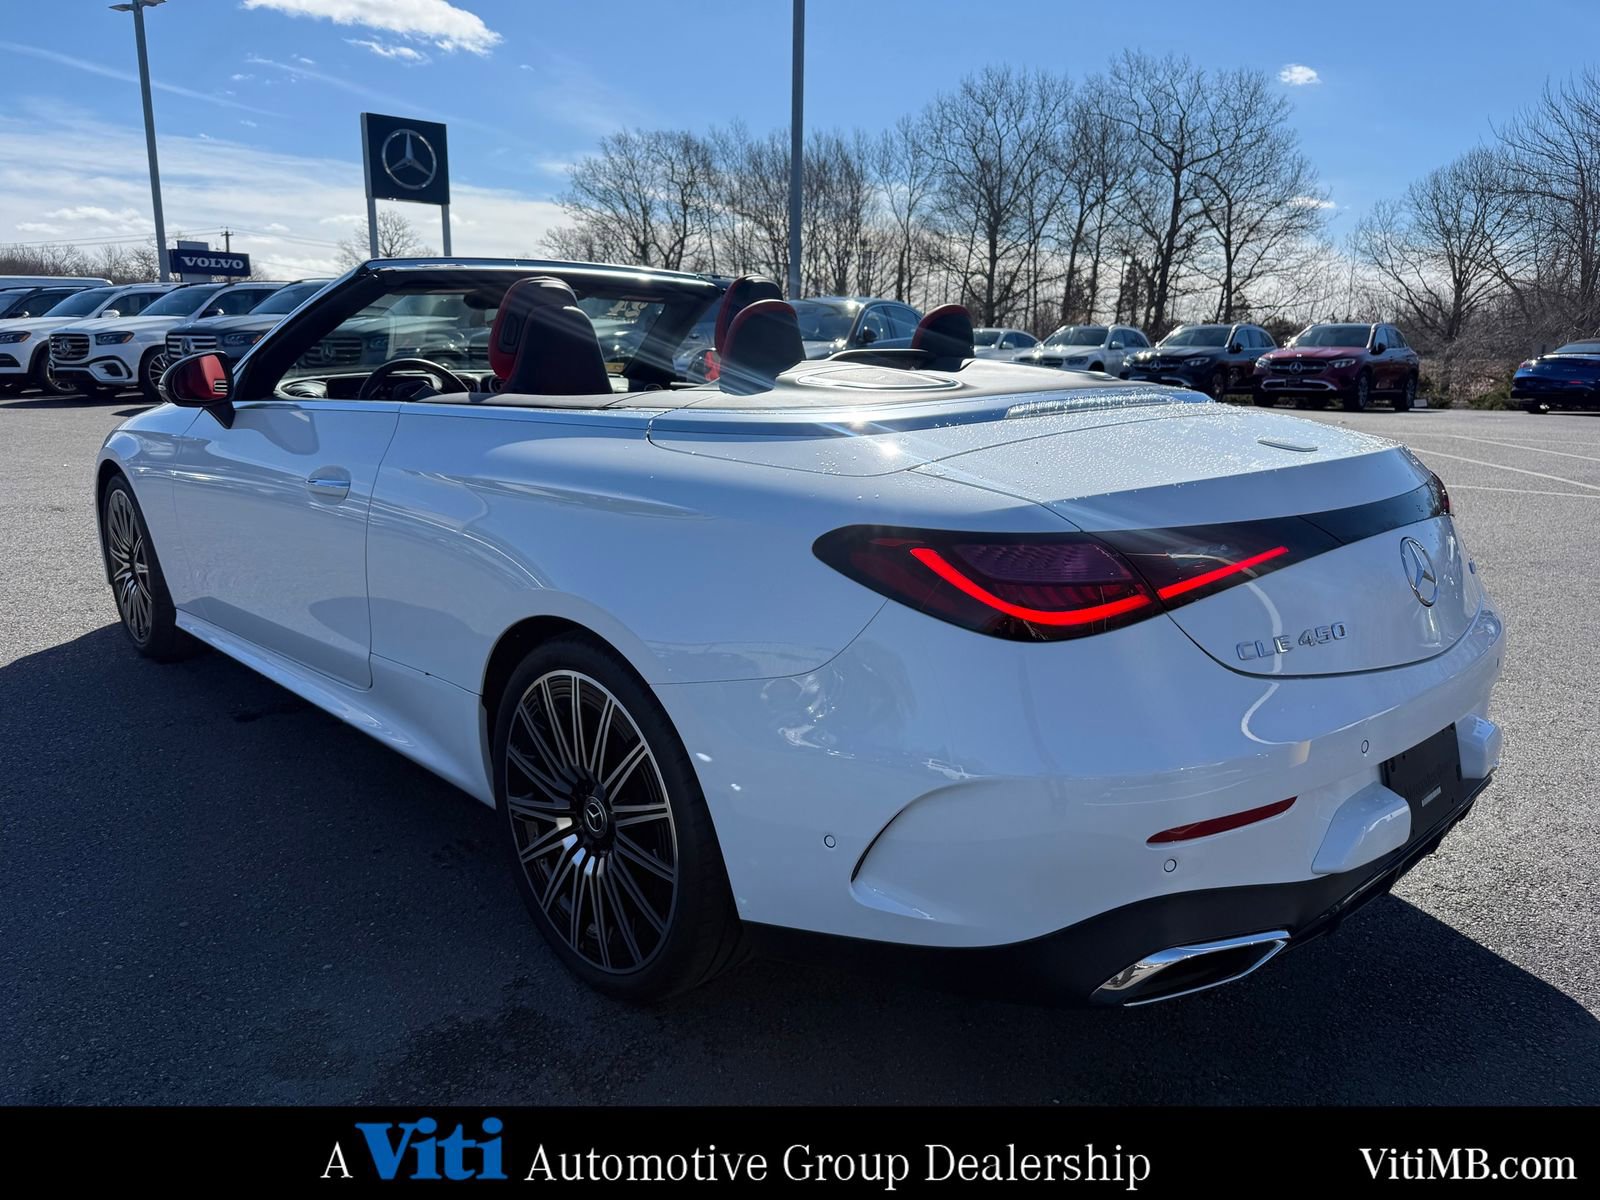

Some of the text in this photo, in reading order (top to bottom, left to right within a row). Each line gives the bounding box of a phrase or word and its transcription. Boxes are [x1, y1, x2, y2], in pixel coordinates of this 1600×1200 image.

[181, 257, 244, 269] VOLVO
[1236, 621, 1346, 661] CLE 450
